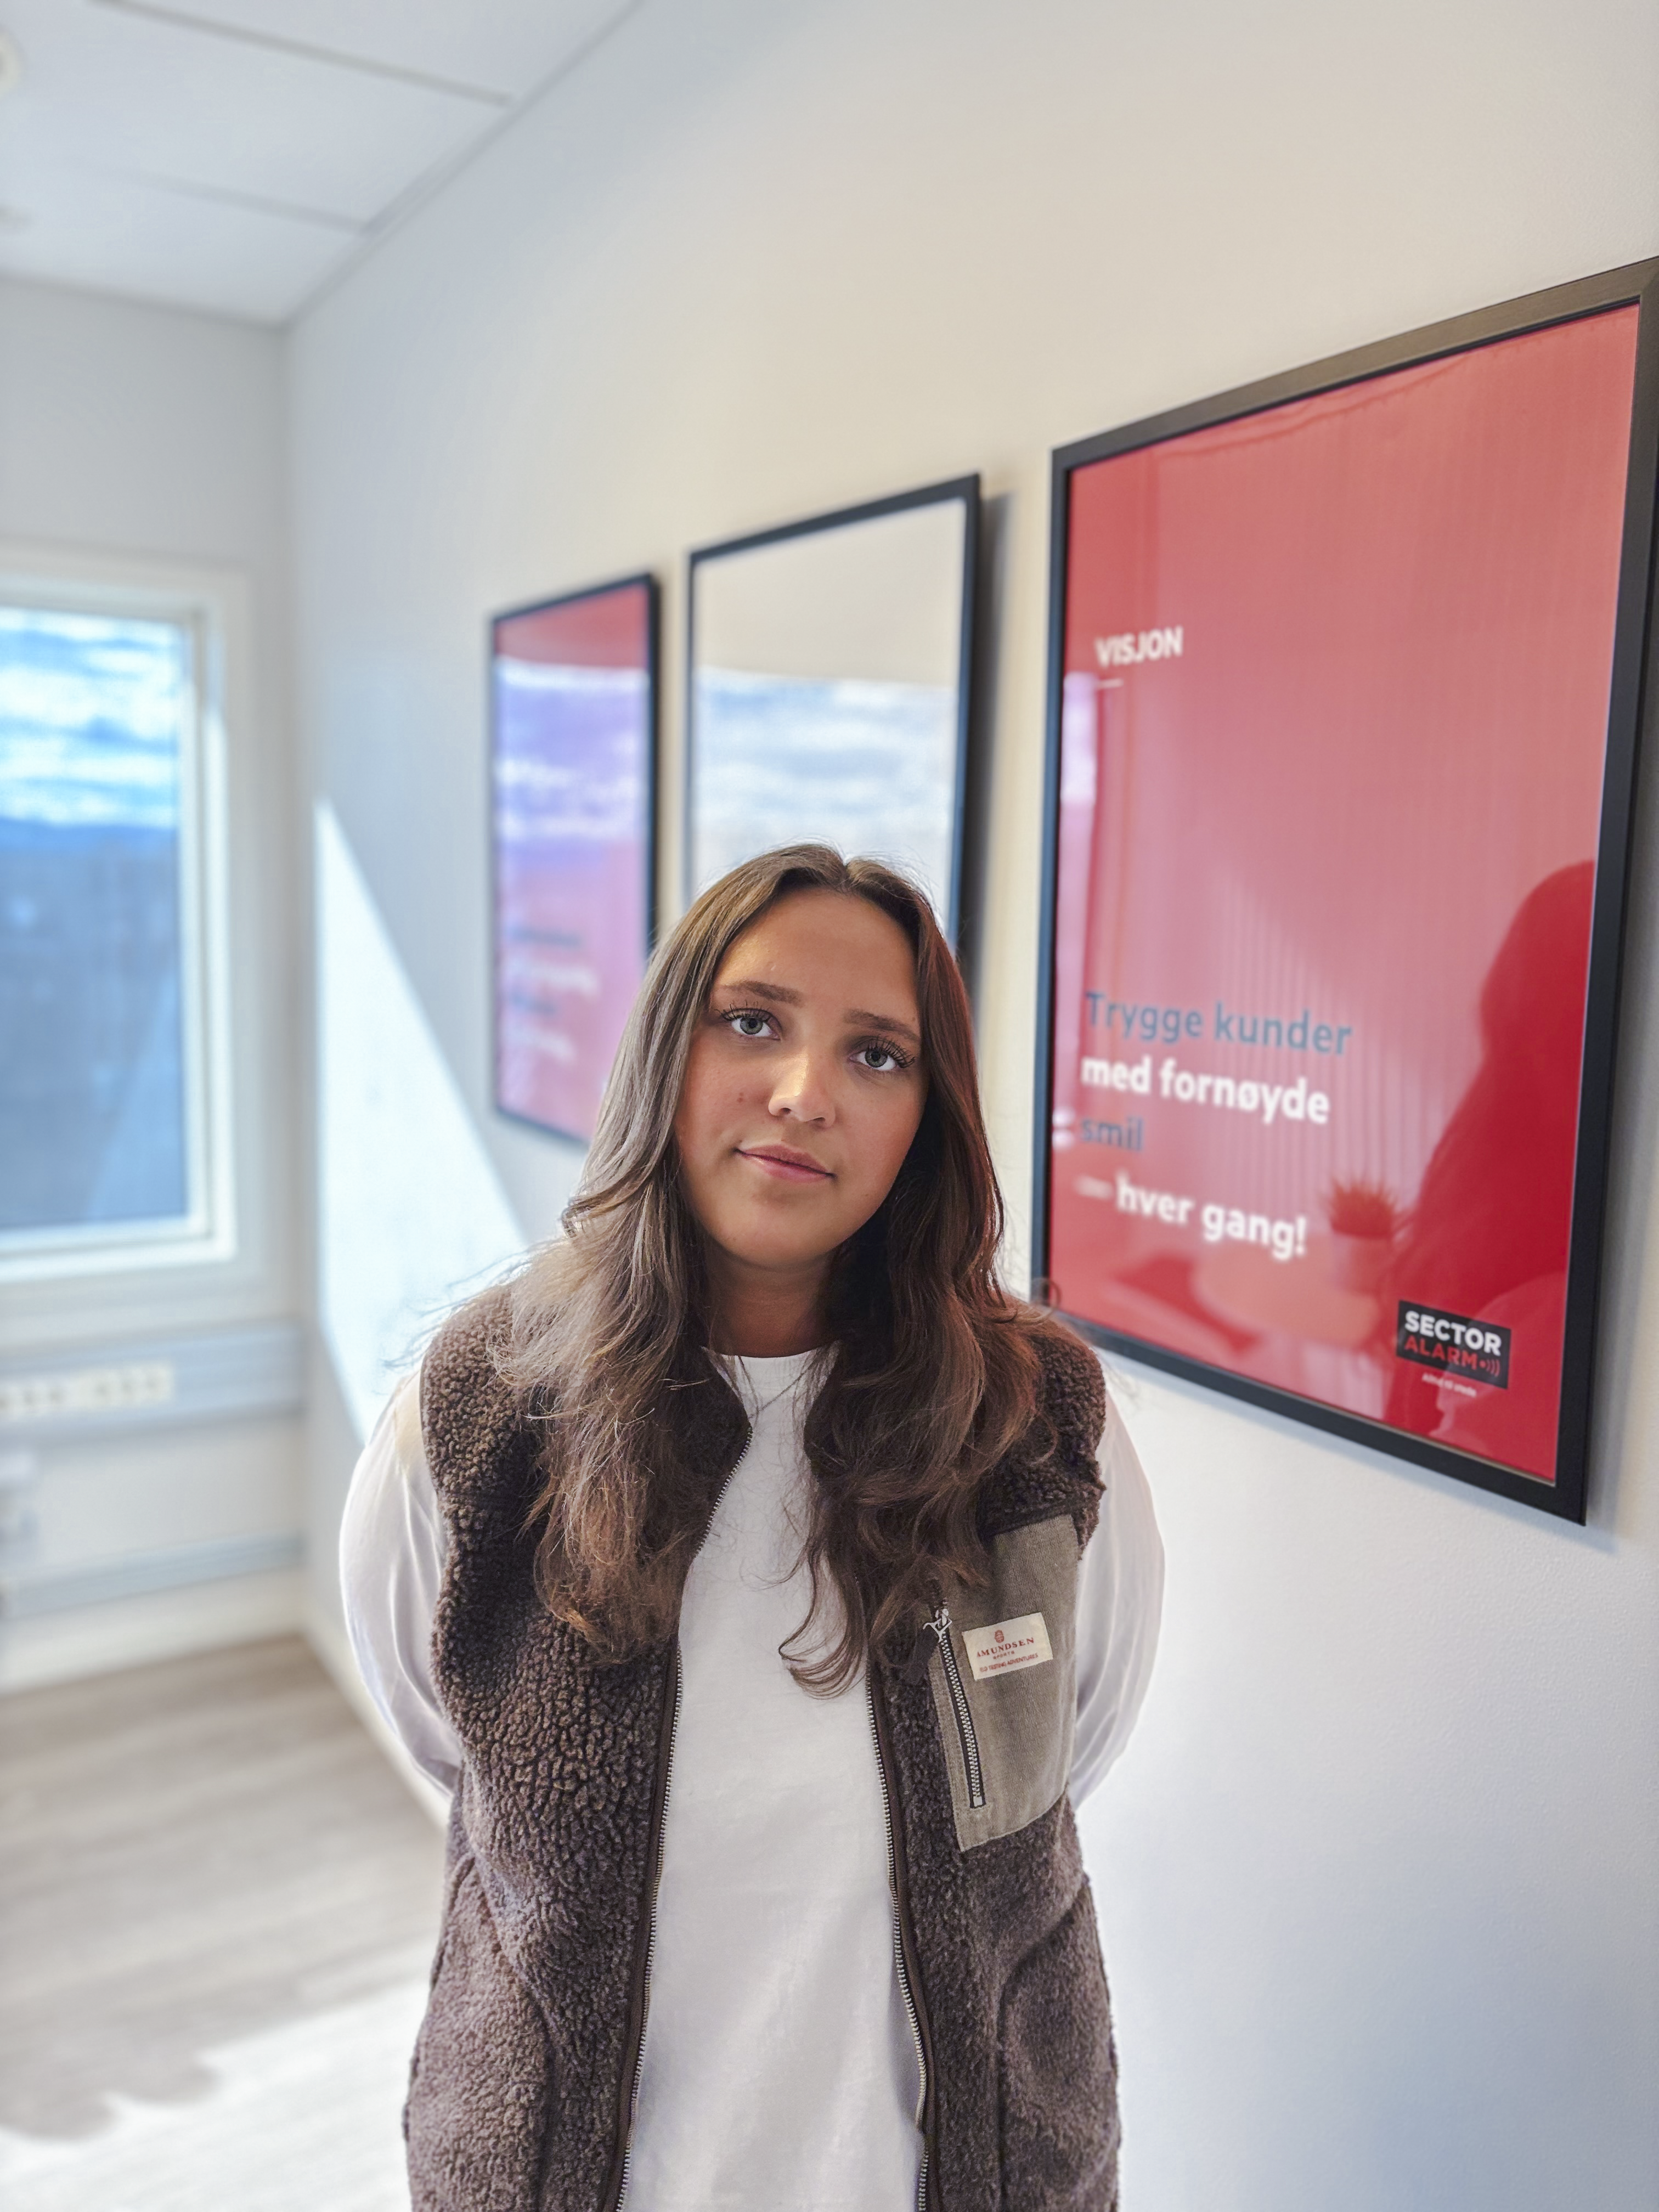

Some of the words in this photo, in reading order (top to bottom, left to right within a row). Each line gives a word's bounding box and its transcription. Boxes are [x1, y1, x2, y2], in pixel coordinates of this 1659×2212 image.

[1095, 625, 1184, 667] VISJON
[1086, 991, 1203, 1043] Trygge
[1214, 1002, 1352, 1054] kunder
[1081, 1055, 1151, 1094] med
[1160, 1058, 1330, 1124] fornøyde
[1080, 1116, 1144, 1152] smil
[1116, 1169, 1195, 1224] hver
[1201, 1204, 1307, 1261] gang!
[1404, 1310, 1502, 1357] SECTOR
[1404, 1335, 1478, 1370] ALARM
[977, 1637, 1035, 1657] AMUNDSEN
[1007, 1652, 1039, 1665] ADVENTURES
